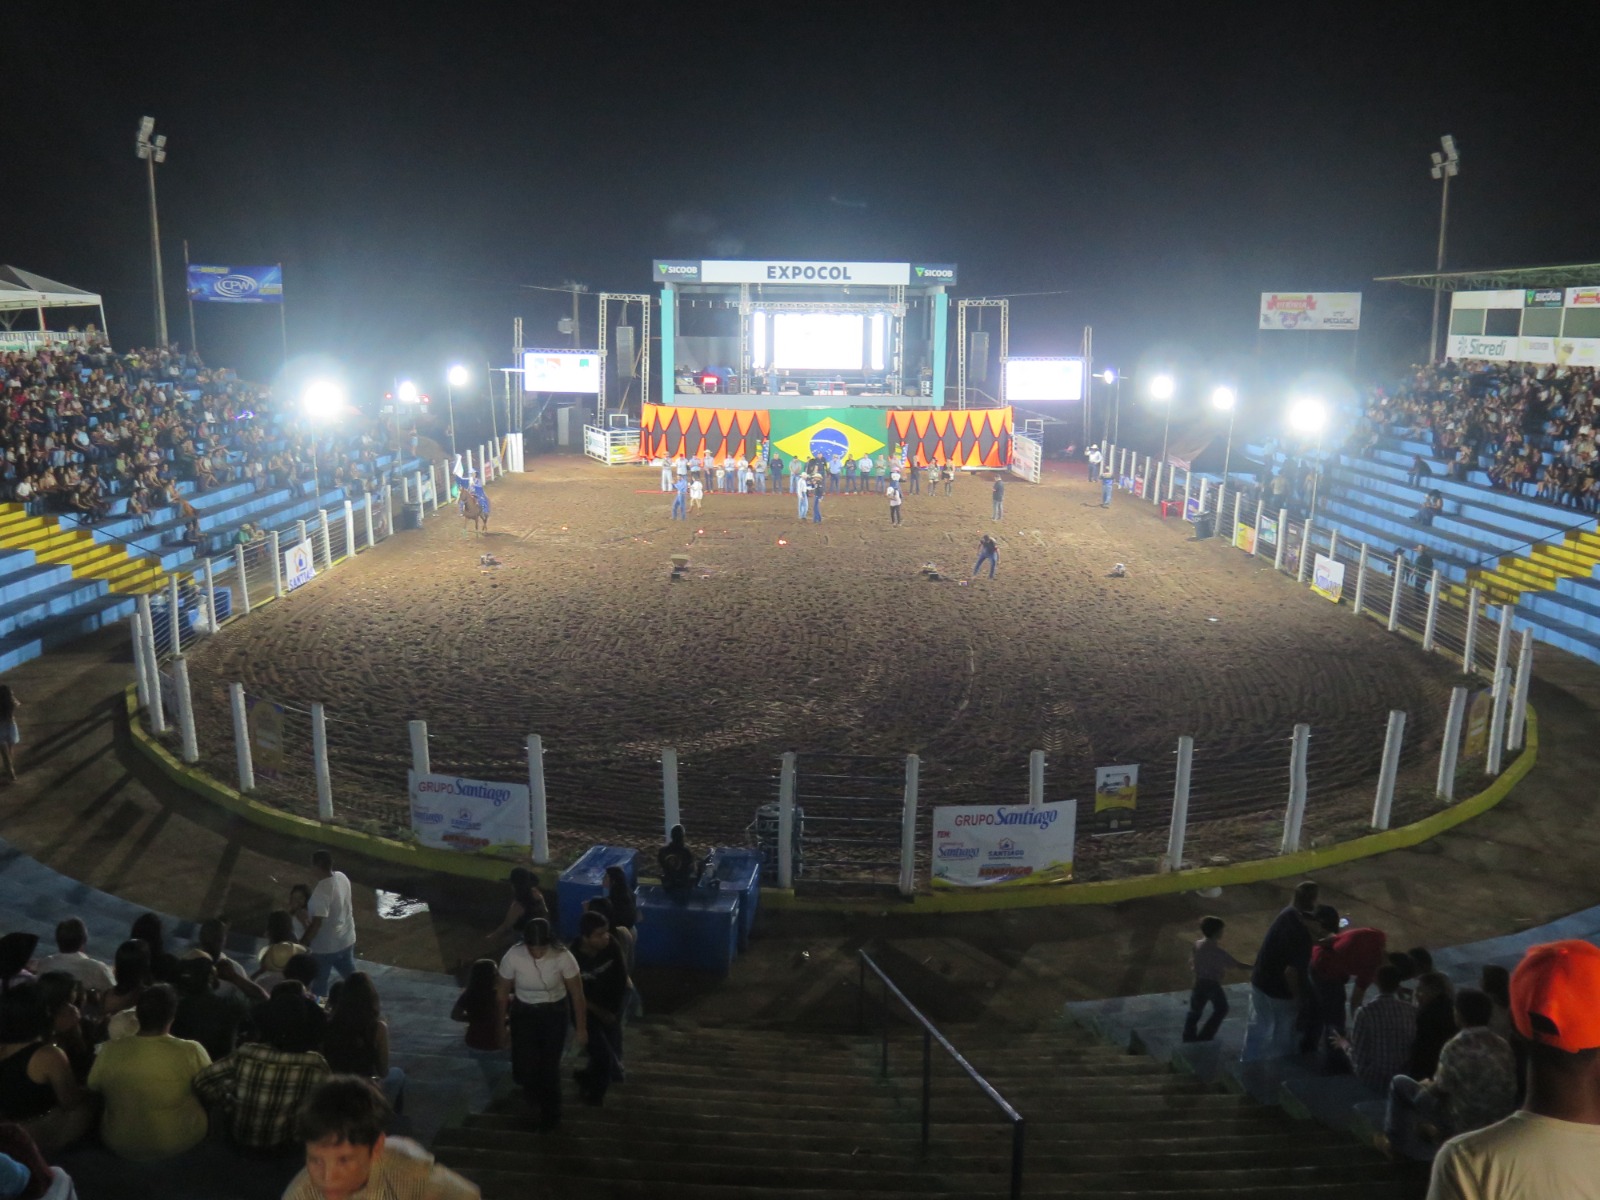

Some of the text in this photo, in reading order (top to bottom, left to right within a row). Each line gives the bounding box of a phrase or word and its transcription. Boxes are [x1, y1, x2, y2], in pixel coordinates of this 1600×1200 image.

[668, 266, 698, 274] SICOOB
[766, 265, 852, 281] EXPOCOL
[924, 269, 953, 278] SICOOB
[222, 280, 250, 291] CPW
[1469, 339, 1507, 356] Sicredi
[418, 778, 511, 807] GRUPO Santiago
[954, 807, 1058, 830] GRUPO Santiago
[937, 846, 980, 859] Santiago
[988, 849, 1025, 857] SANTIAGO
